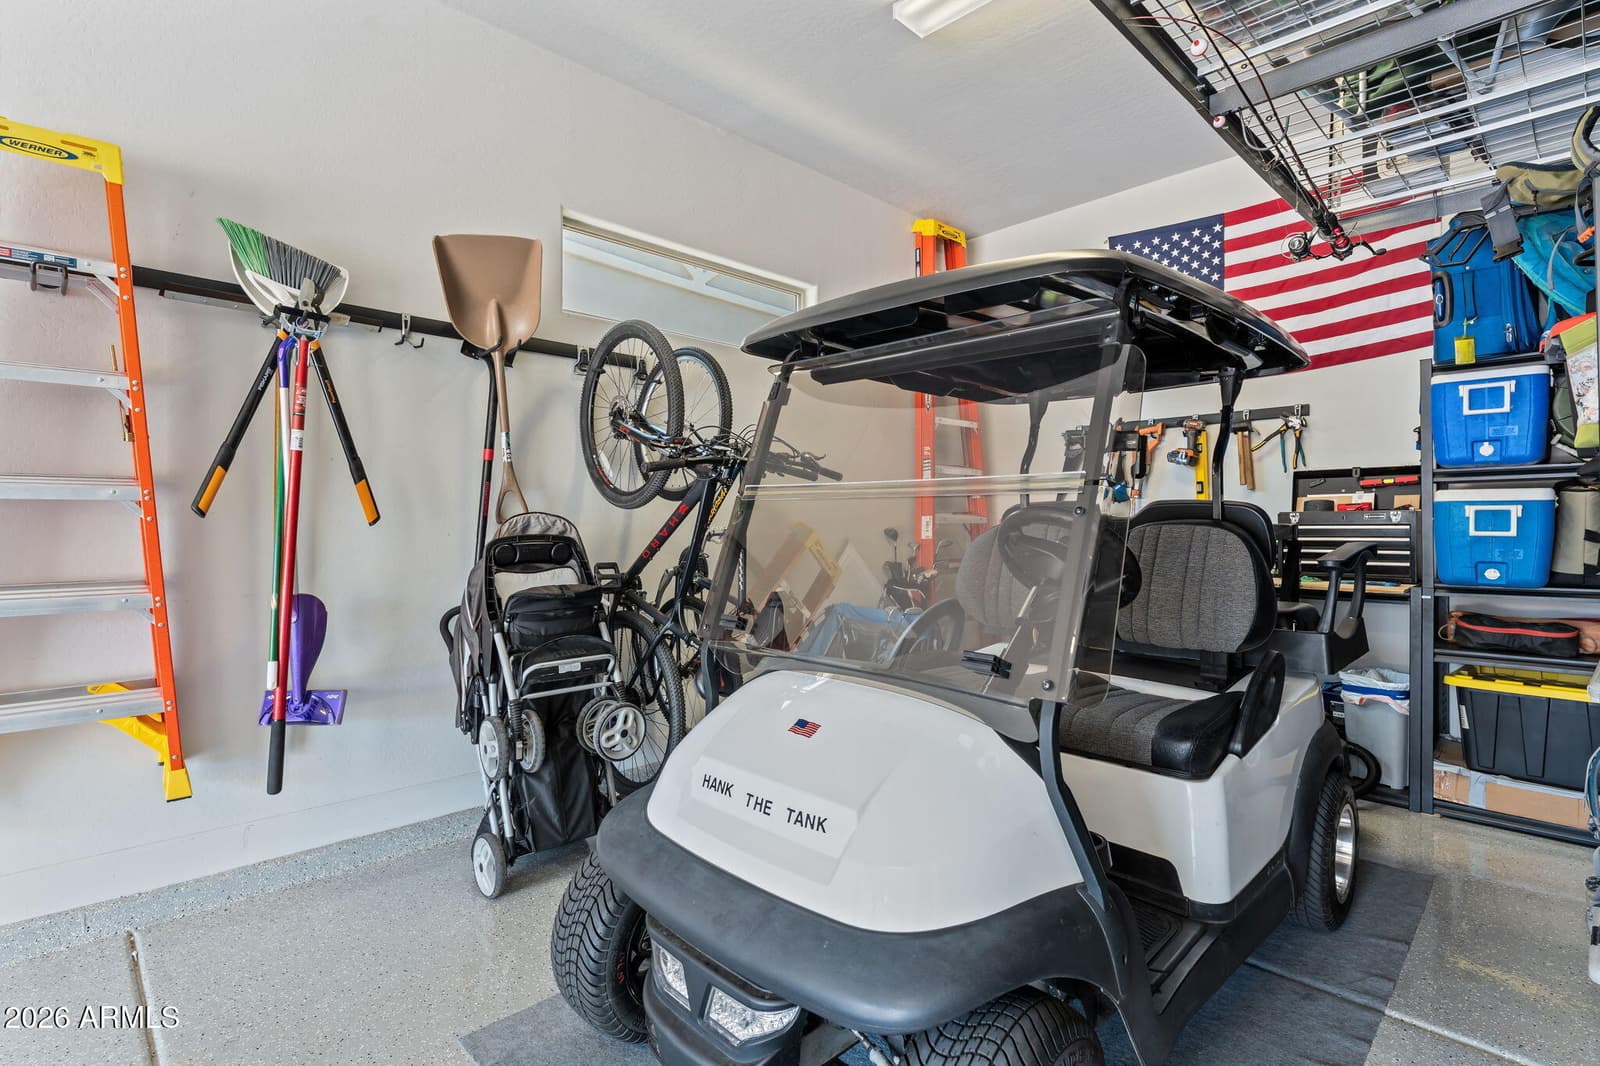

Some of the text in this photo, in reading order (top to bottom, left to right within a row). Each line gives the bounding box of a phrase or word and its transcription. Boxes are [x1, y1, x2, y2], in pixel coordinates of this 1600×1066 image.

[9, 139, 64, 157] WERNER
[641, 516, 680, 559] HARO
[702, 773, 828, 833] HANK THE TANK
